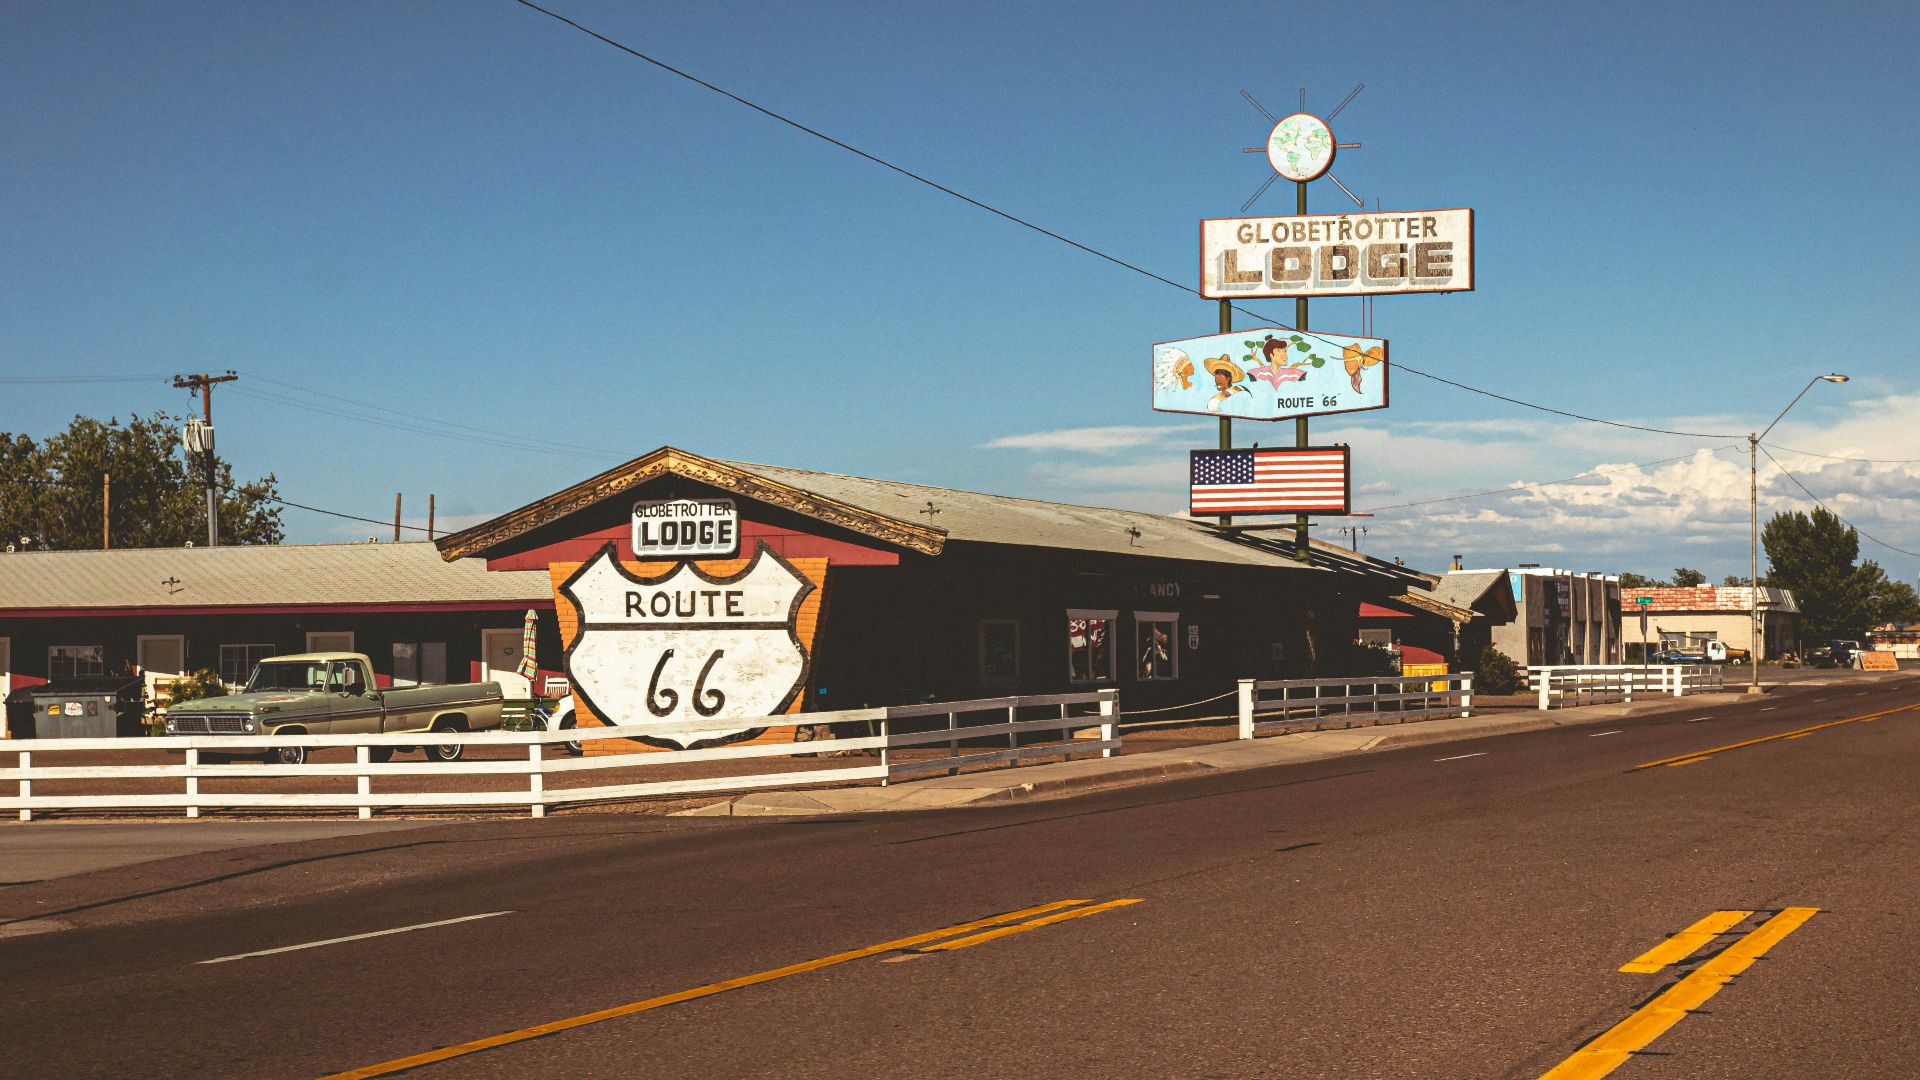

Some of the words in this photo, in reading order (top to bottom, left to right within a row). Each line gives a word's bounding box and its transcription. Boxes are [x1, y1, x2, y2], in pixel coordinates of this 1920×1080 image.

[1236, 216, 1438, 245] GLOBETROTTER
[1218, 241, 1453, 290] LODGE
[1277, 396, 1314, 409] ROUTE
[634, 501, 732, 518] GLOBETROTTER
[639, 519, 733, 549] LODGE
[625, 590, 745, 618] ROUTE
[646, 648, 727, 718] 66
